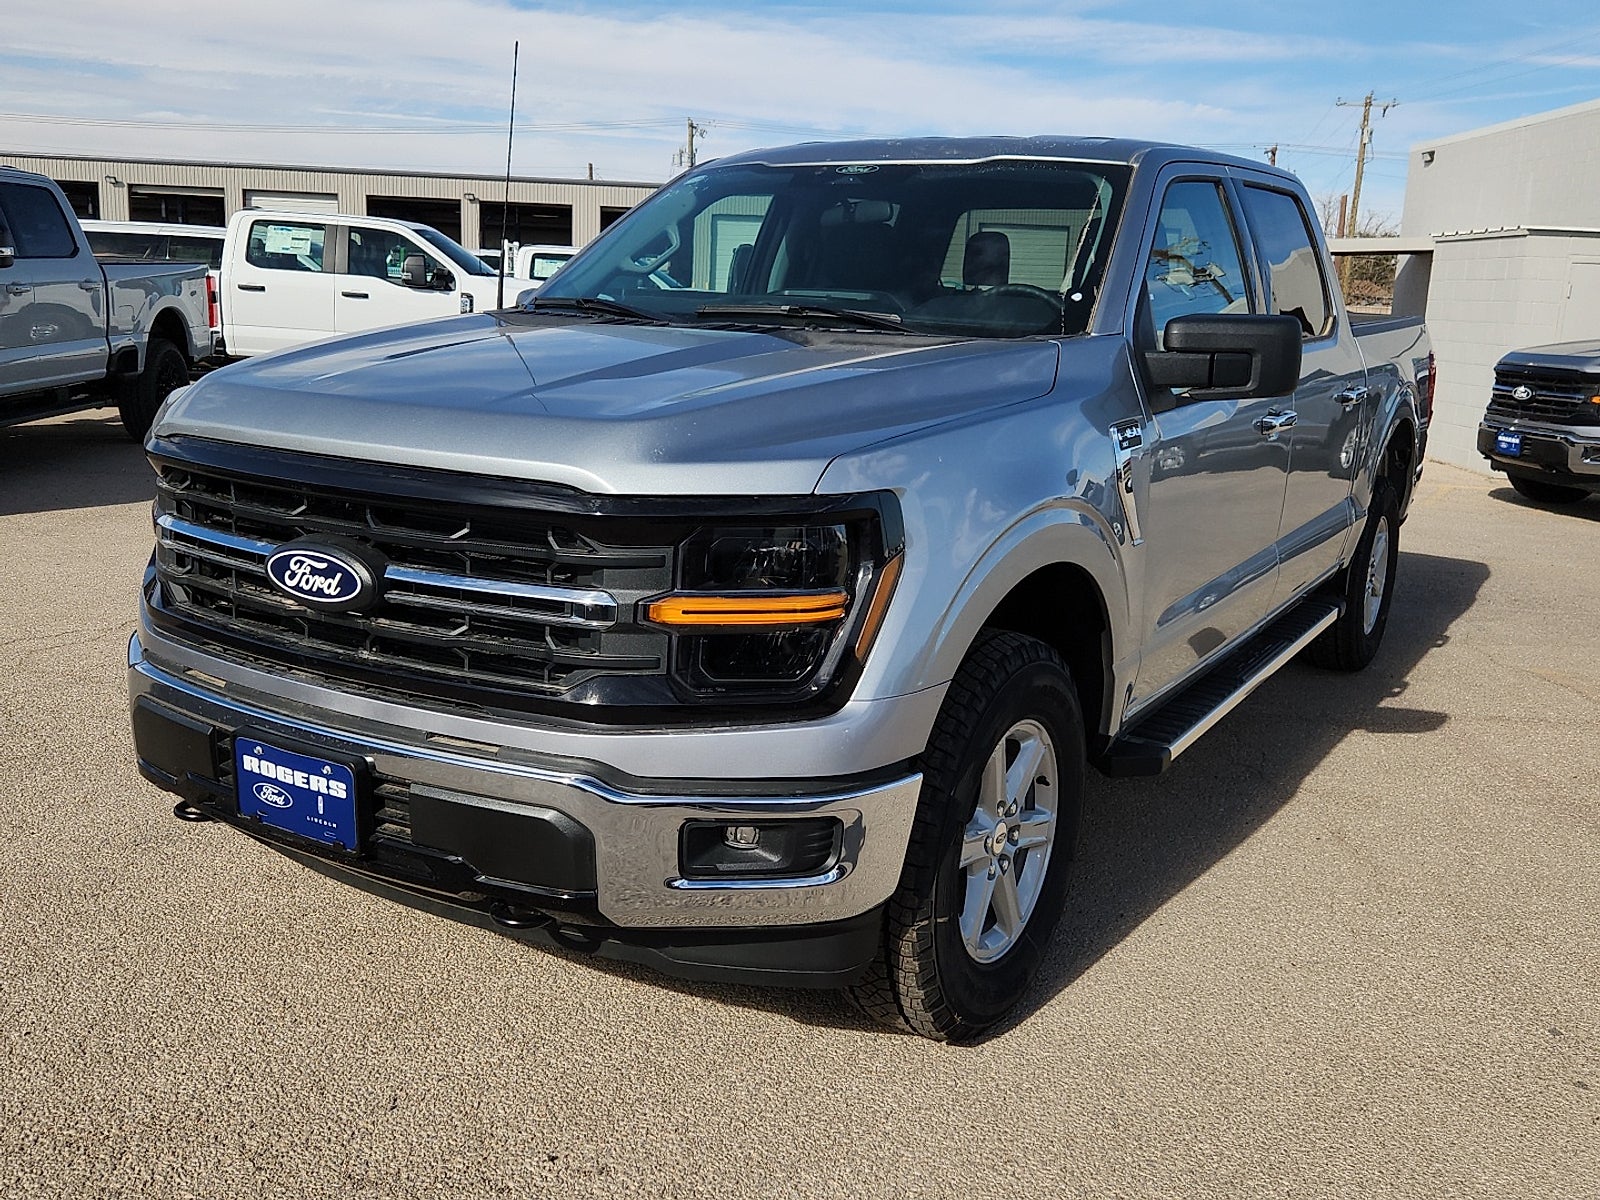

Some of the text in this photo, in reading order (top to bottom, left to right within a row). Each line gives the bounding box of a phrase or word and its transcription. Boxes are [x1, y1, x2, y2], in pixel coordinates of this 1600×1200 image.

[284, 555, 343, 596] Ford
[242, 754, 347, 799] ROGERS
[260, 784, 286, 806] Ford
